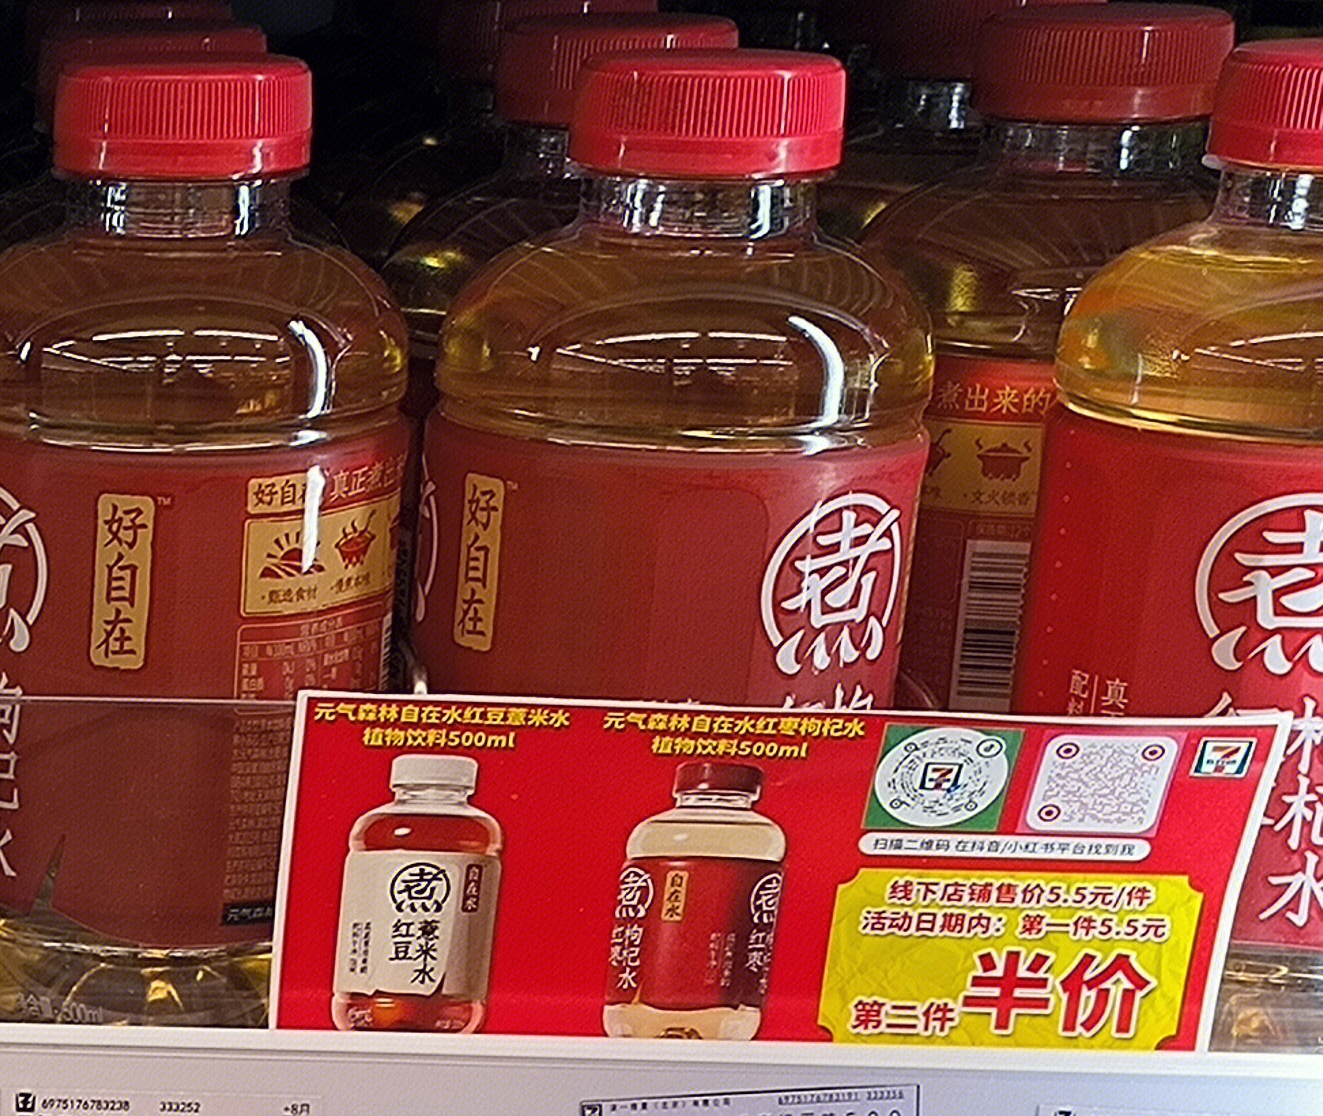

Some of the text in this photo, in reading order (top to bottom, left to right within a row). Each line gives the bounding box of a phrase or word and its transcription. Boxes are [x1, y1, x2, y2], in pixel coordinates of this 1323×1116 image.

[934, 382, 1053, 416] 煮出来的
[254, 478, 306, 508] 好自
[456, 483, 499, 640] 好自在
[96, 503, 148, 659] 好自在
[761, 492, 901, 675] 煮
[314, 702, 570, 728] 元气森林自在水红豆薏米水
[603, 711, 866, 738] 元气森林自在水红枣枸杞水
[362, 727, 516, 749] 植物饮料500ml
[651, 735, 809, 758] 植物饮料500ml
[873, 836, 1138, 858] 扫描二维码 在抖音/小红书平台找到我
[390, 862, 450, 913] 煮
[615, 868, 653, 918] 煮
[888, 881, 1153, 908] 线下店铺售价5.5元/件
[389, 919, 415, 961] 红豆
[410, 919, 440, 984] 薏米水
[851, 949, 1156, 1035] 第二件半价
